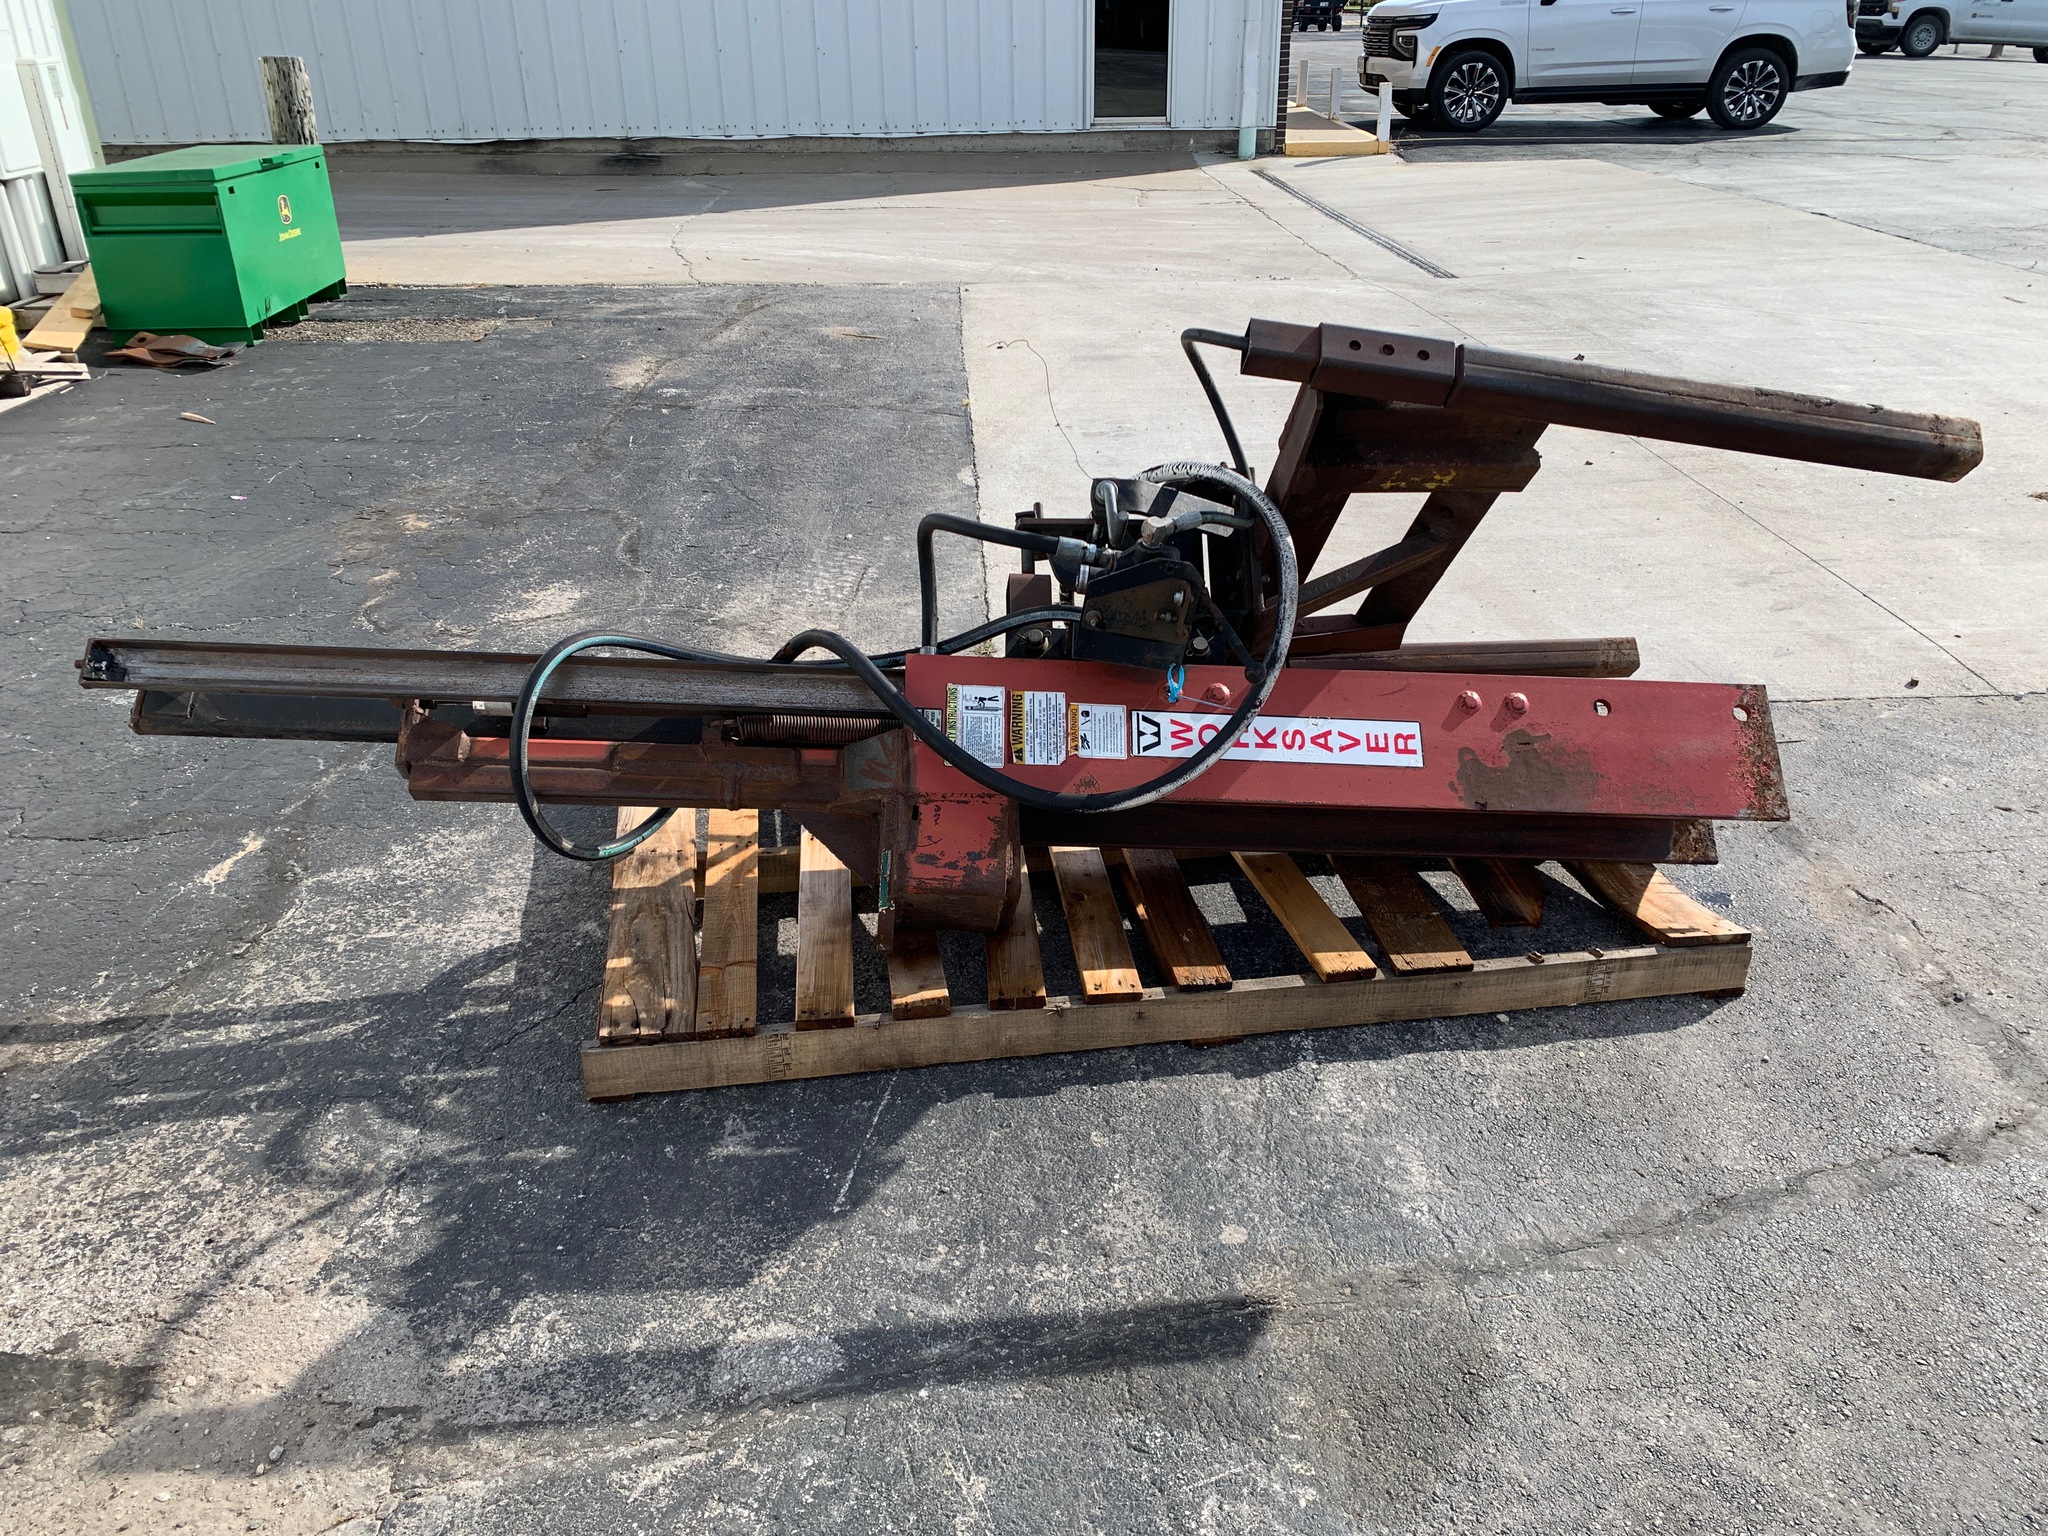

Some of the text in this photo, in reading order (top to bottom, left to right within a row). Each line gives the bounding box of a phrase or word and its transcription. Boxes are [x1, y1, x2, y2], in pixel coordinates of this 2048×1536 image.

[947, 686, 957, 731] INSTRUCTIONS
[1011, 693, 1024, 746] WARNING
[1070, 708, 1079, 743] WARNING
